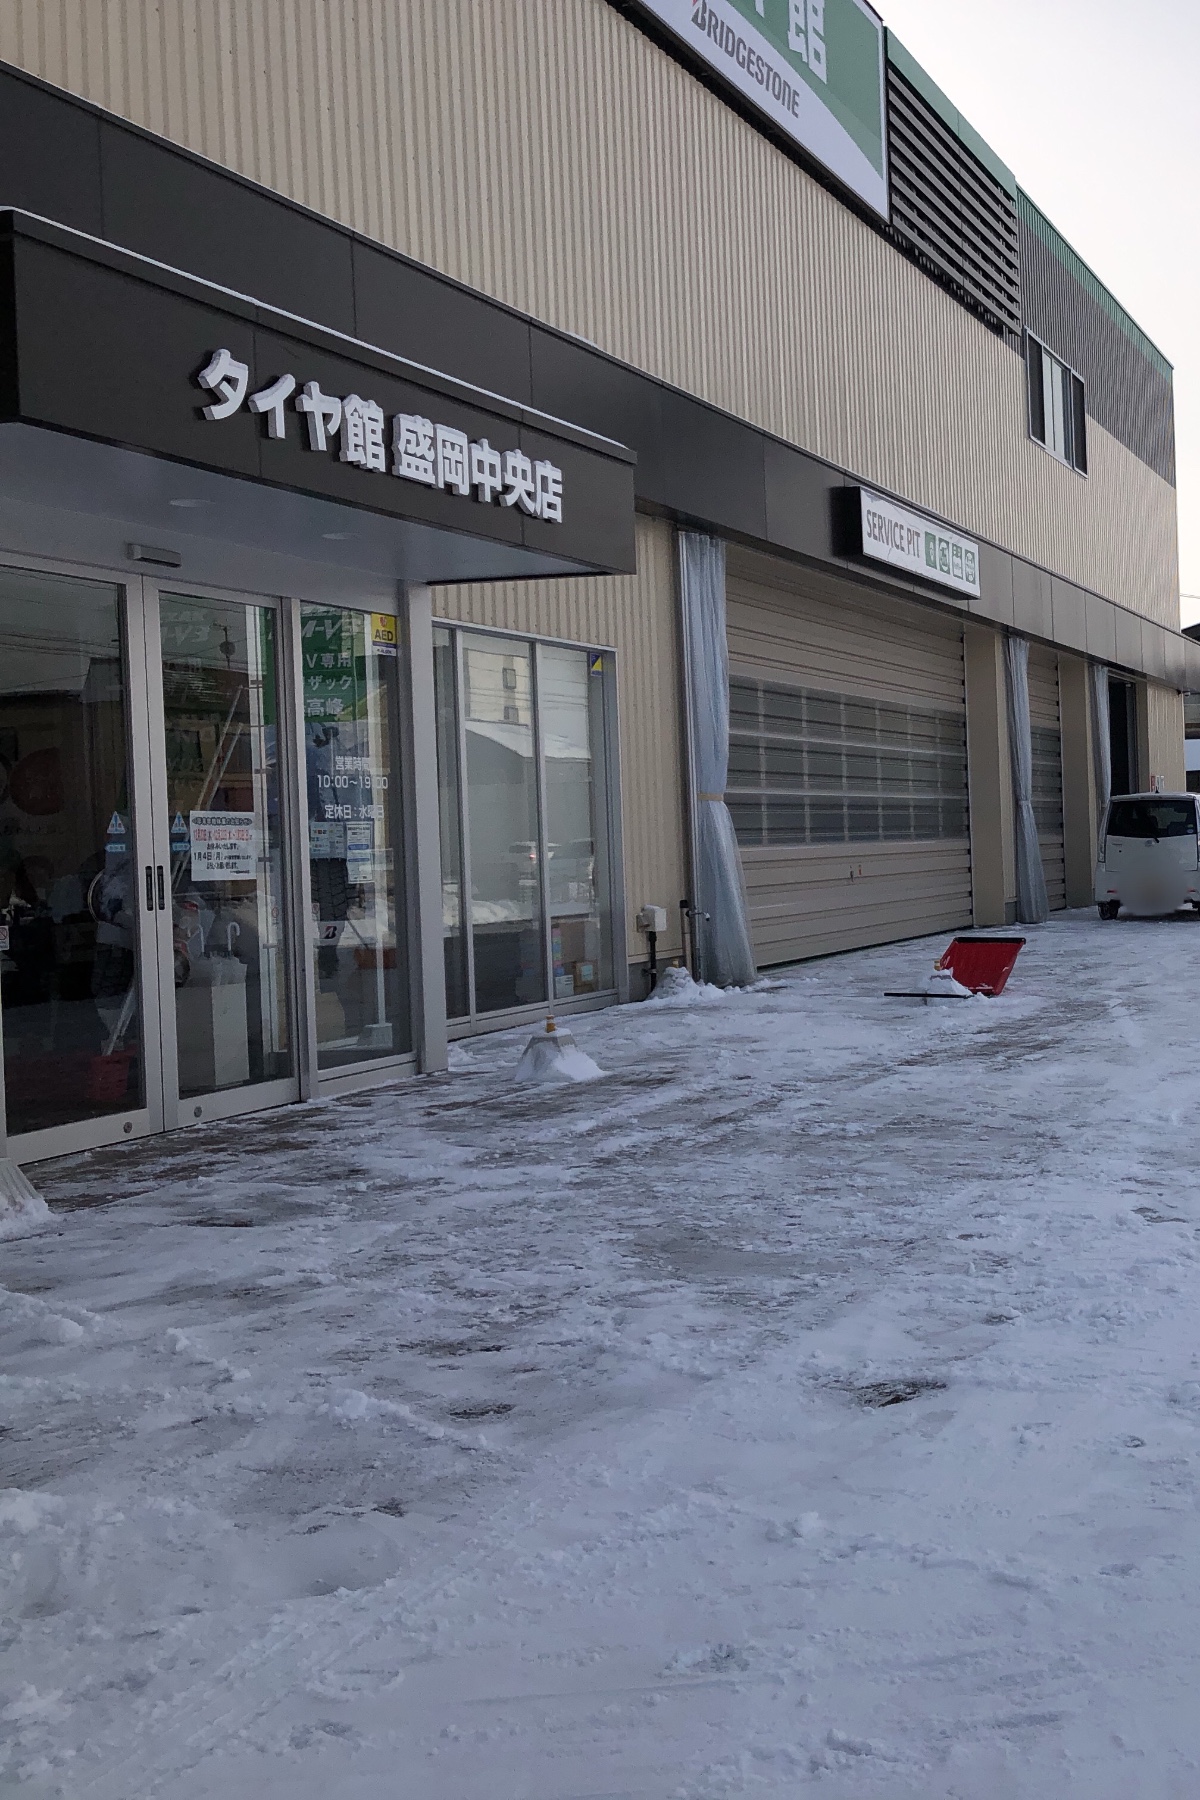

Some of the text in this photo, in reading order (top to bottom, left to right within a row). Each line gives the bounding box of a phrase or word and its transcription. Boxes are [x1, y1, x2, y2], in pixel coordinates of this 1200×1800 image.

[691, 0, 800, 119] BRIDGESTONE
[198, 348, 564, 524] タイヤ館 盛岡中央店
[866, 509, 921, 559] SERVICE PIT
[374, 628, 394, 642] AED
[303, 675, 353, 691] ザック
[303, 697, 344, 718] 高峰
